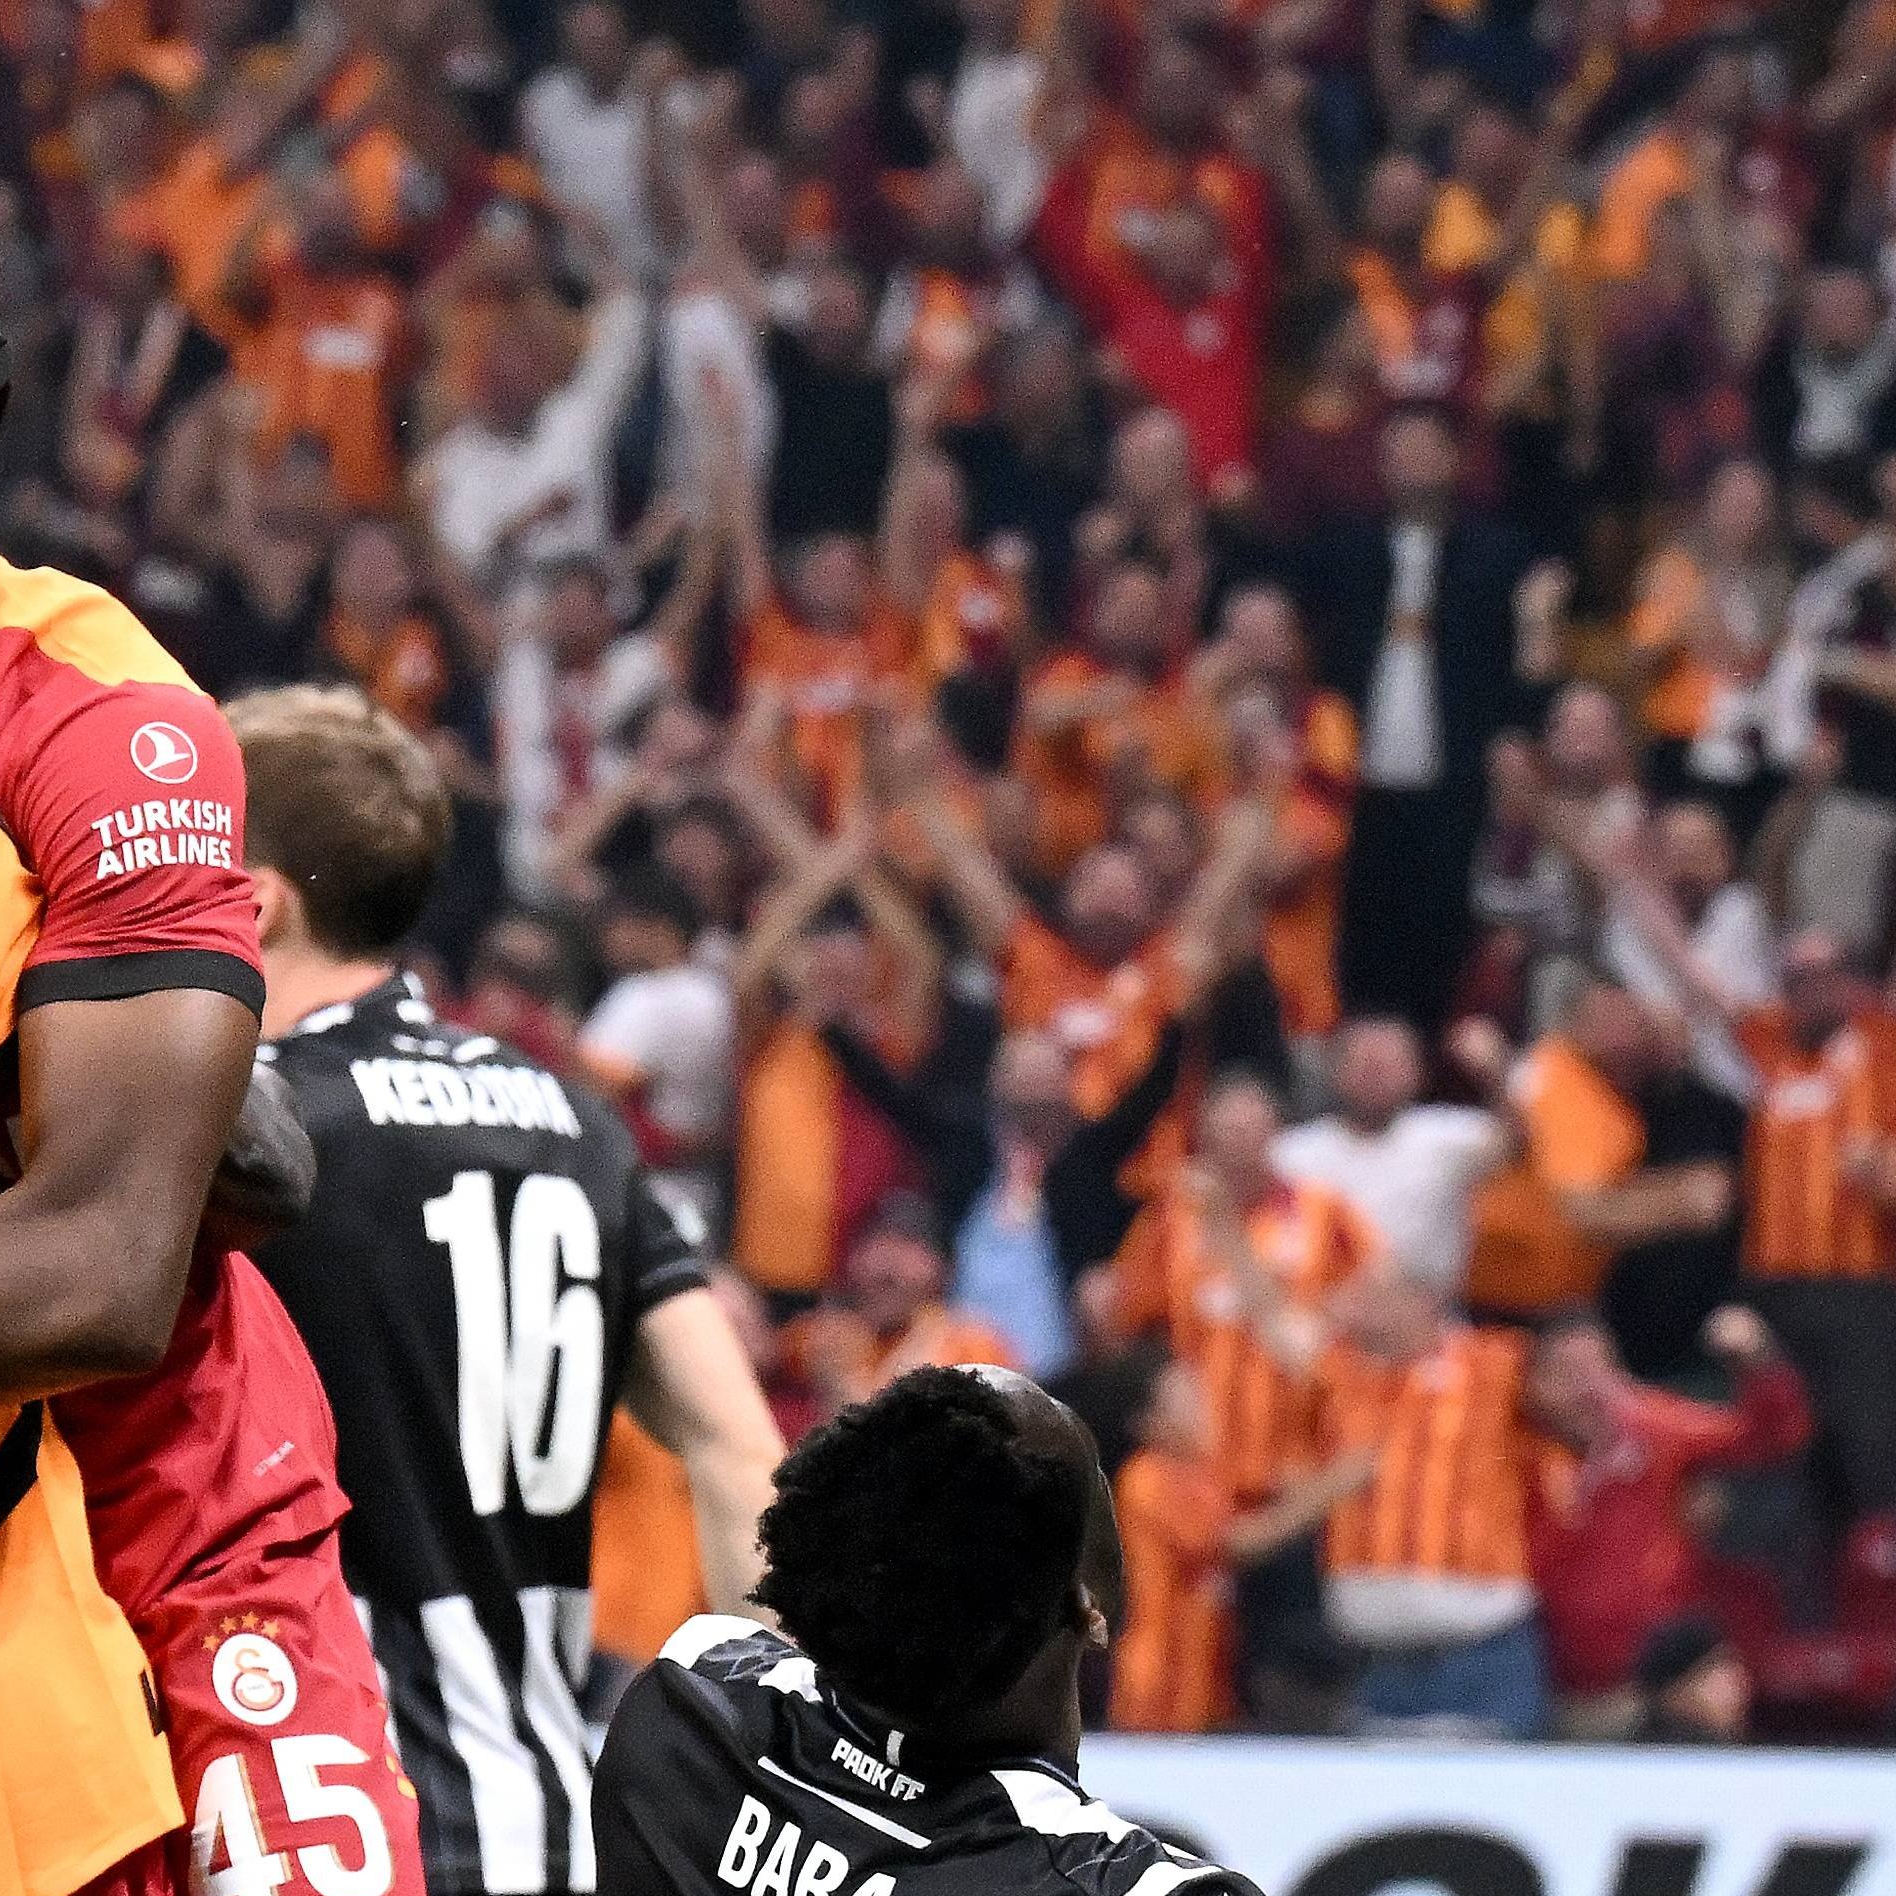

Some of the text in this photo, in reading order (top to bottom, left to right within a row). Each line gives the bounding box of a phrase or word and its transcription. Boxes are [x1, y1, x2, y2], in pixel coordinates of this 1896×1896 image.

[91, 798, 232, 849] TURKISH
[96, 833, 232, 880] AIRLINES
[423, 1170, 603, 1516] 16
[830, 1737, 926, 1801] PAOK FC
